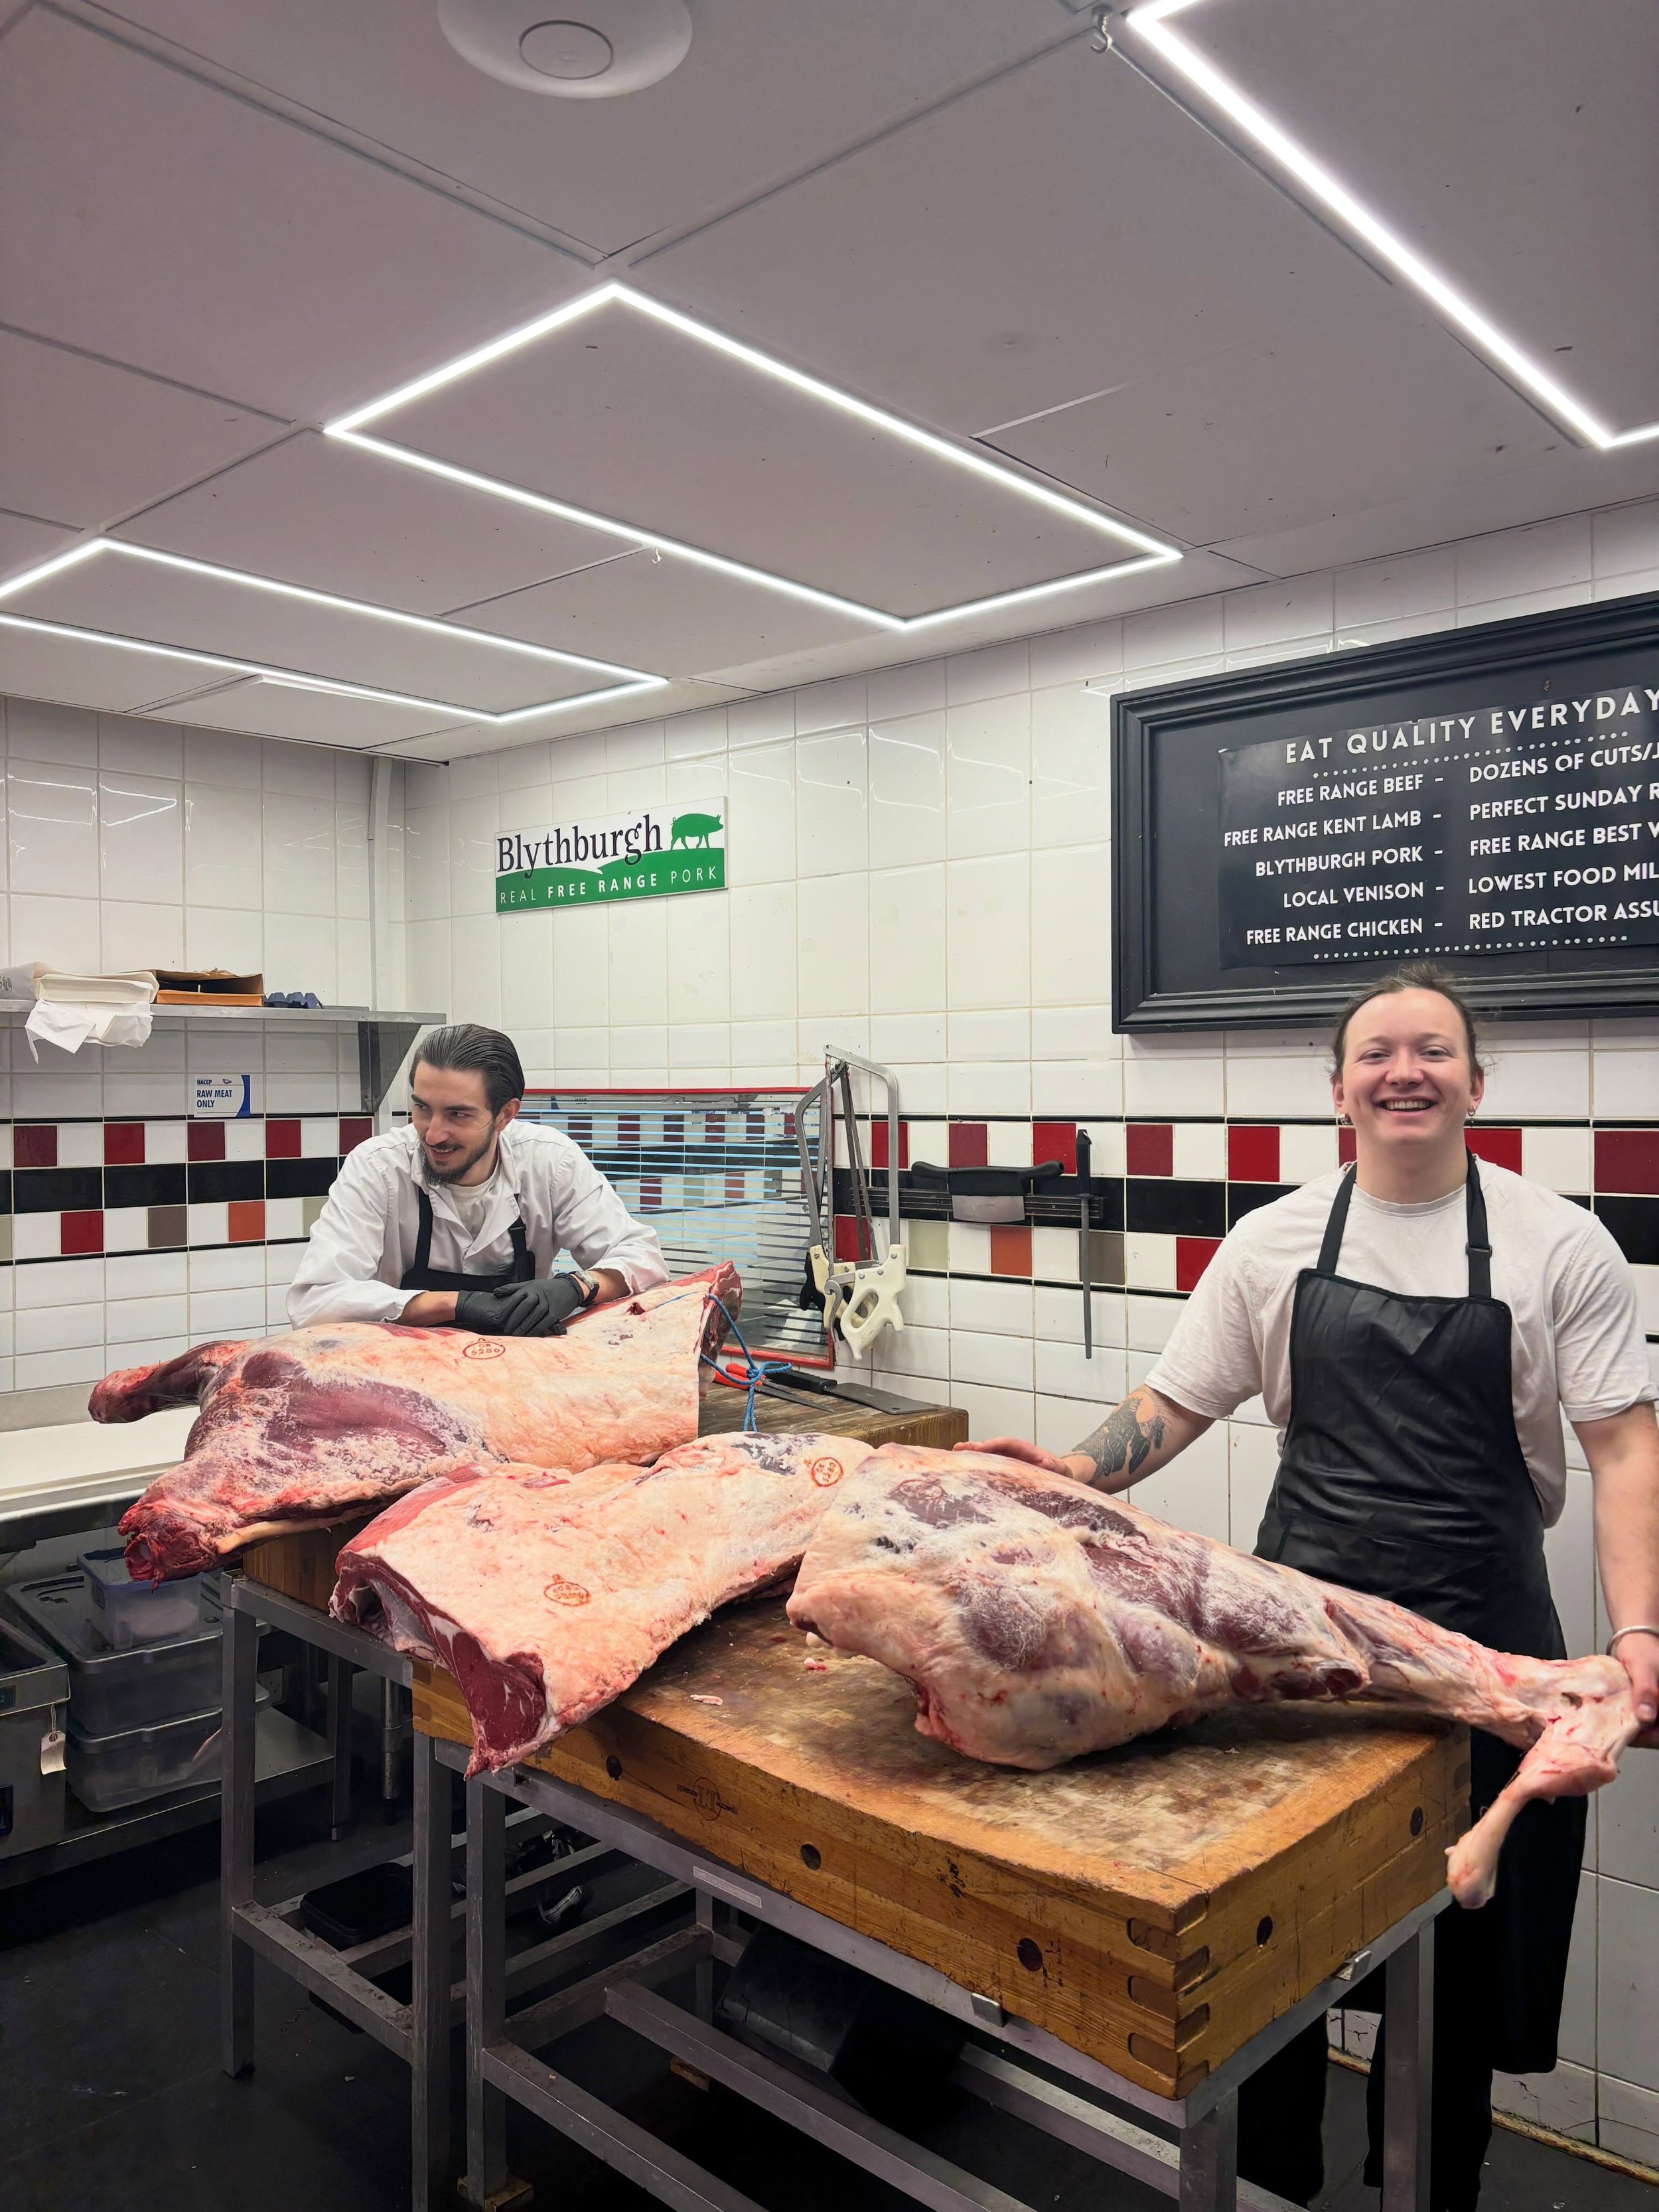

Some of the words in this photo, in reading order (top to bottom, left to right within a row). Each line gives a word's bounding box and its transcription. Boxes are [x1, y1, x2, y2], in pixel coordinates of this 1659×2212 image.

[1286, 737, 1333, 764] EAT
[1346, 716, 1476, 755] QUALITY
[1490, 688, 1659, 735] EVERYDAY
[1277, 786, 1314, 806] FREE
[1319, 779, 1378, 801] RANGE
[1384, 773, 1423, 794] BEEF
[1469, 757, 1548, 783] DOZENS
[1555, 753, 1584, 772] OF
[1224, 828, 1258, 848] FREE
[1263, 821, 1318, 842] RANGE
[1323, 816, 1367, 836] KENT
[1372, 810, 1421, 830] LAMB
[1470, 796, 1549, 821] PERFECT
[1555, 784, 1643, 811] SUNDAY
[496, 814, 663, 879] Blythburgh
[1256, 851, 1366, 877] BLYTHBURGH
[1372, 846, 1423, 865] PORK
[1470, 836, 1511, 856] FREE
[1518, 829, 1585, 851] RANGE
[1593, 822, 1642, 844] BEST
[500, 888, 536, 905] REAL
[547, 882, 587, 899] FREE
[599, 873, 658, 893] RANGE
[670, 866, 717, 884] PORK
[1283, 889, 1338, 909] LOCAL
[1342, 881, 1423, 903] VENISON
[1469, 871, 1547, 894] LOWEST
[1553, 866, 1617, 887] FOOD
[1623, 861, 1659, 881] MIL
[1246, 928, 1281, 945] FREE
[1286, 923, 1342, 942] RANGE
[1347, 917, 1423, 938] CHICKEN
[1469, 912, 1505, 930] RED
[1510, 905, 1607, 926] TRACTOR
